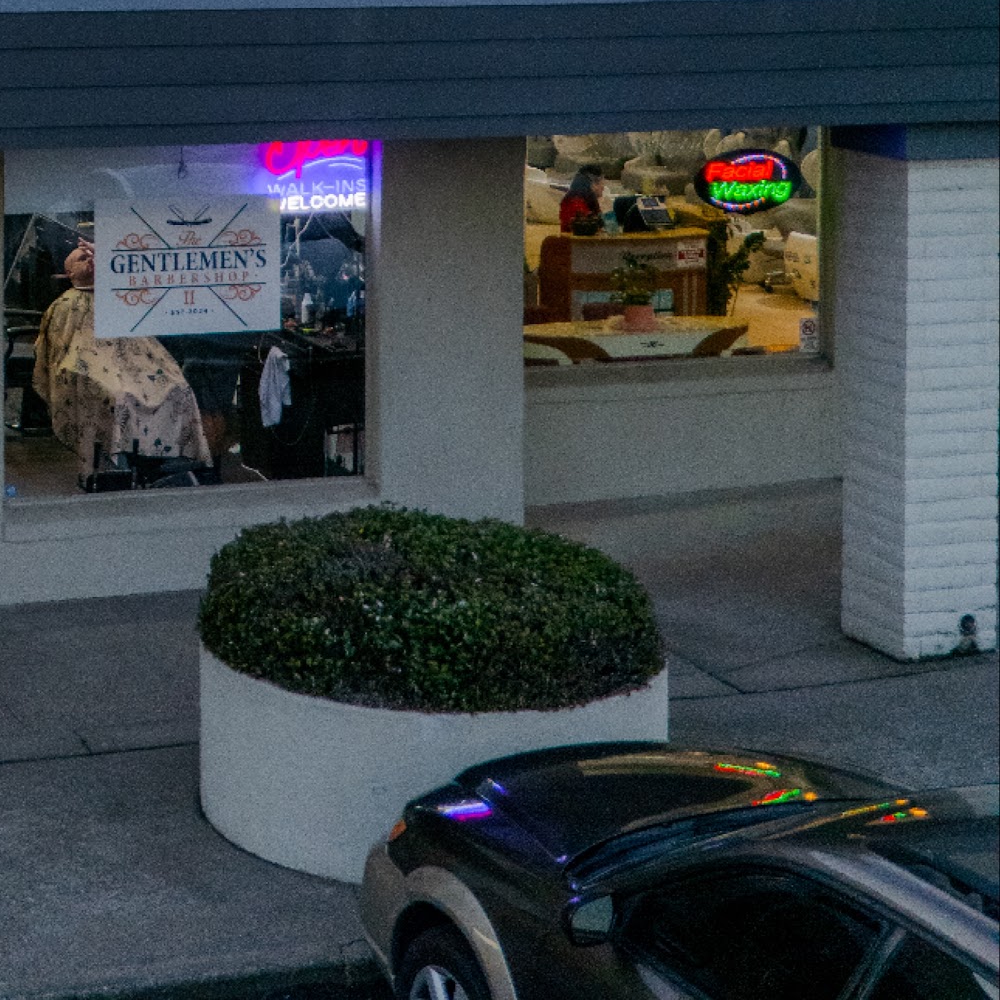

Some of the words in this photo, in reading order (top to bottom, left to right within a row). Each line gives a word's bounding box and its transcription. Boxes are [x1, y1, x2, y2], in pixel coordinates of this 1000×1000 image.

[705, 160, 774, 182] Facial
[267, 179, 367, 196] WALK-INS
[710, 180, 793, 203] Waxing
[176, 230, 202, 246] The
[110, 250, 267, 275] GENTLEMEN'S
[129, 271, 250, 287] BARBERSHOP
